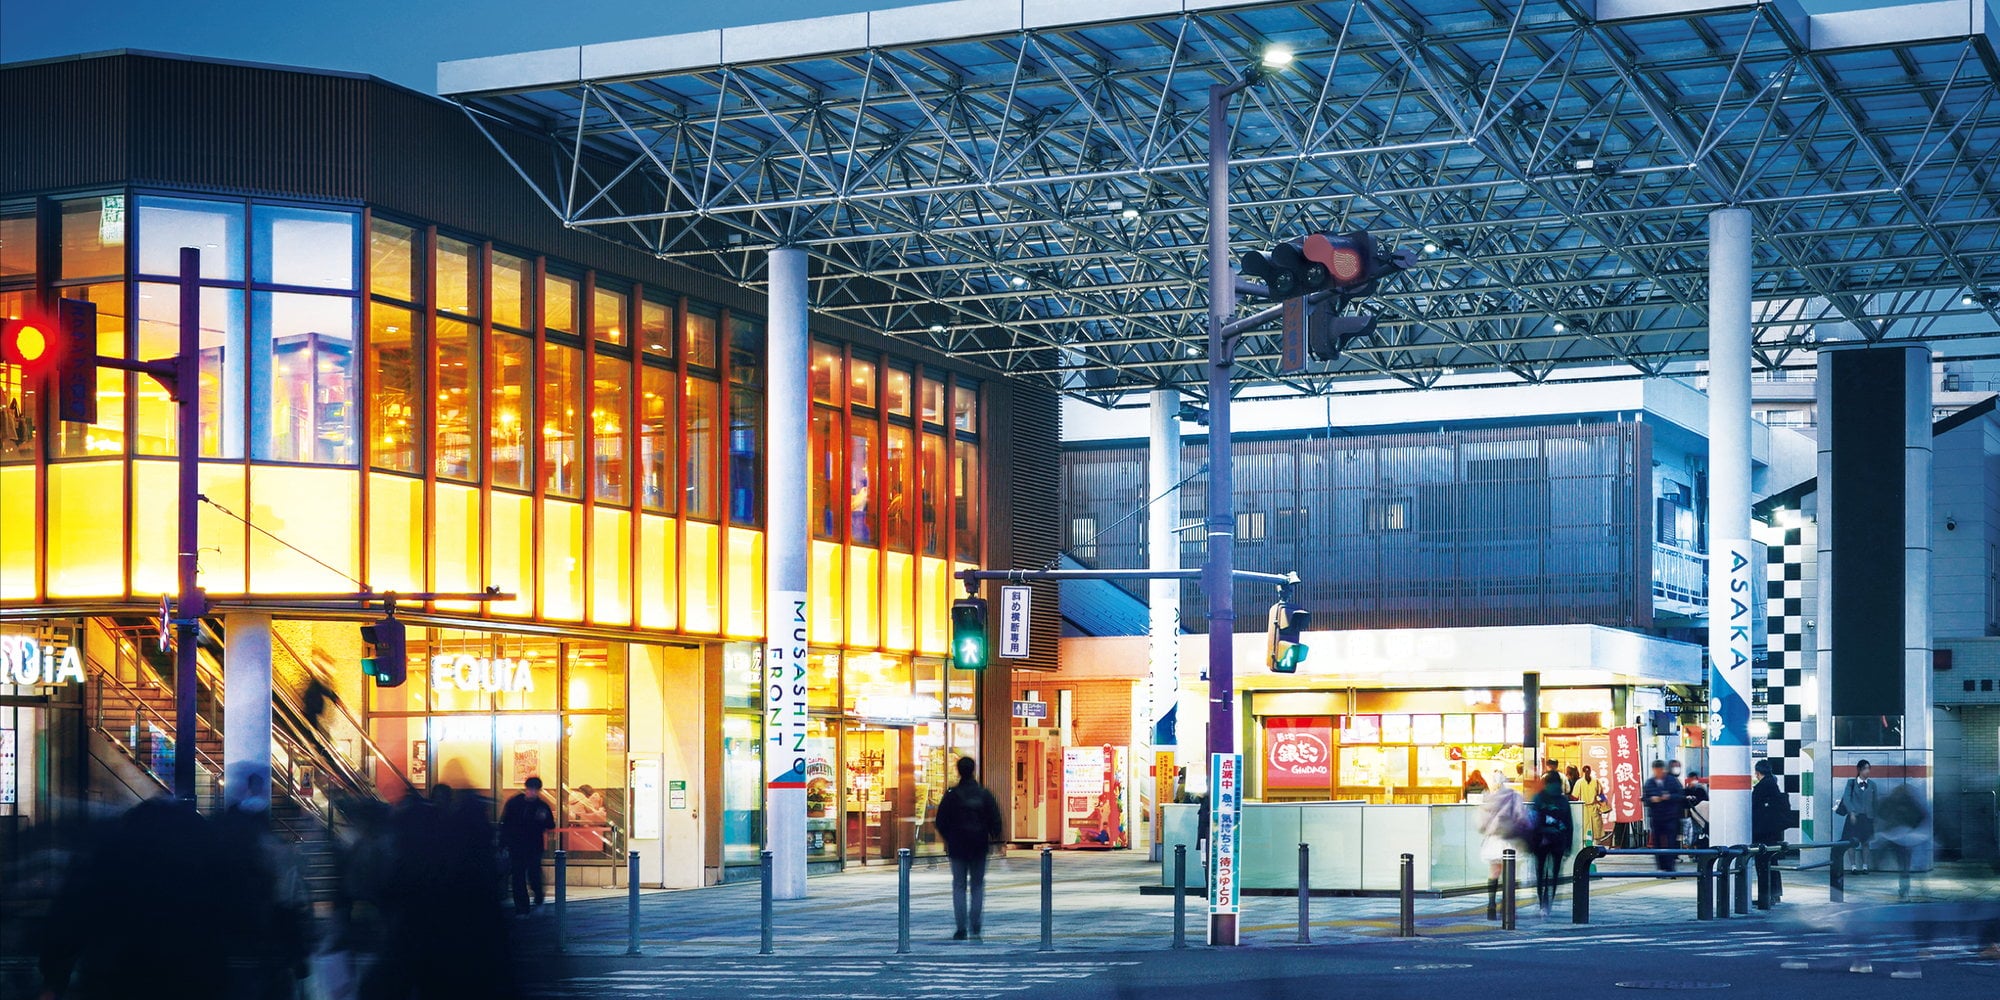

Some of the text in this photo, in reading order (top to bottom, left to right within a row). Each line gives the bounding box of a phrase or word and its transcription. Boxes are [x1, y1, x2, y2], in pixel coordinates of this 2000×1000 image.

[1010, 591, 1021, 652] 斜め横断専用
[1730, 550, 1749, 671] ASAKA
[770, 648, 783, 746] FRONT
[793, 600, 806, 776] MUSASHINO
[1222, 760, 1233, 789] 点滅中
[1278, 740, 1319, 764] 銀だこ
[1614, 762, 1639, 817] 銀だこ
[1219, 857, 1231, 906] 待つゆとり
